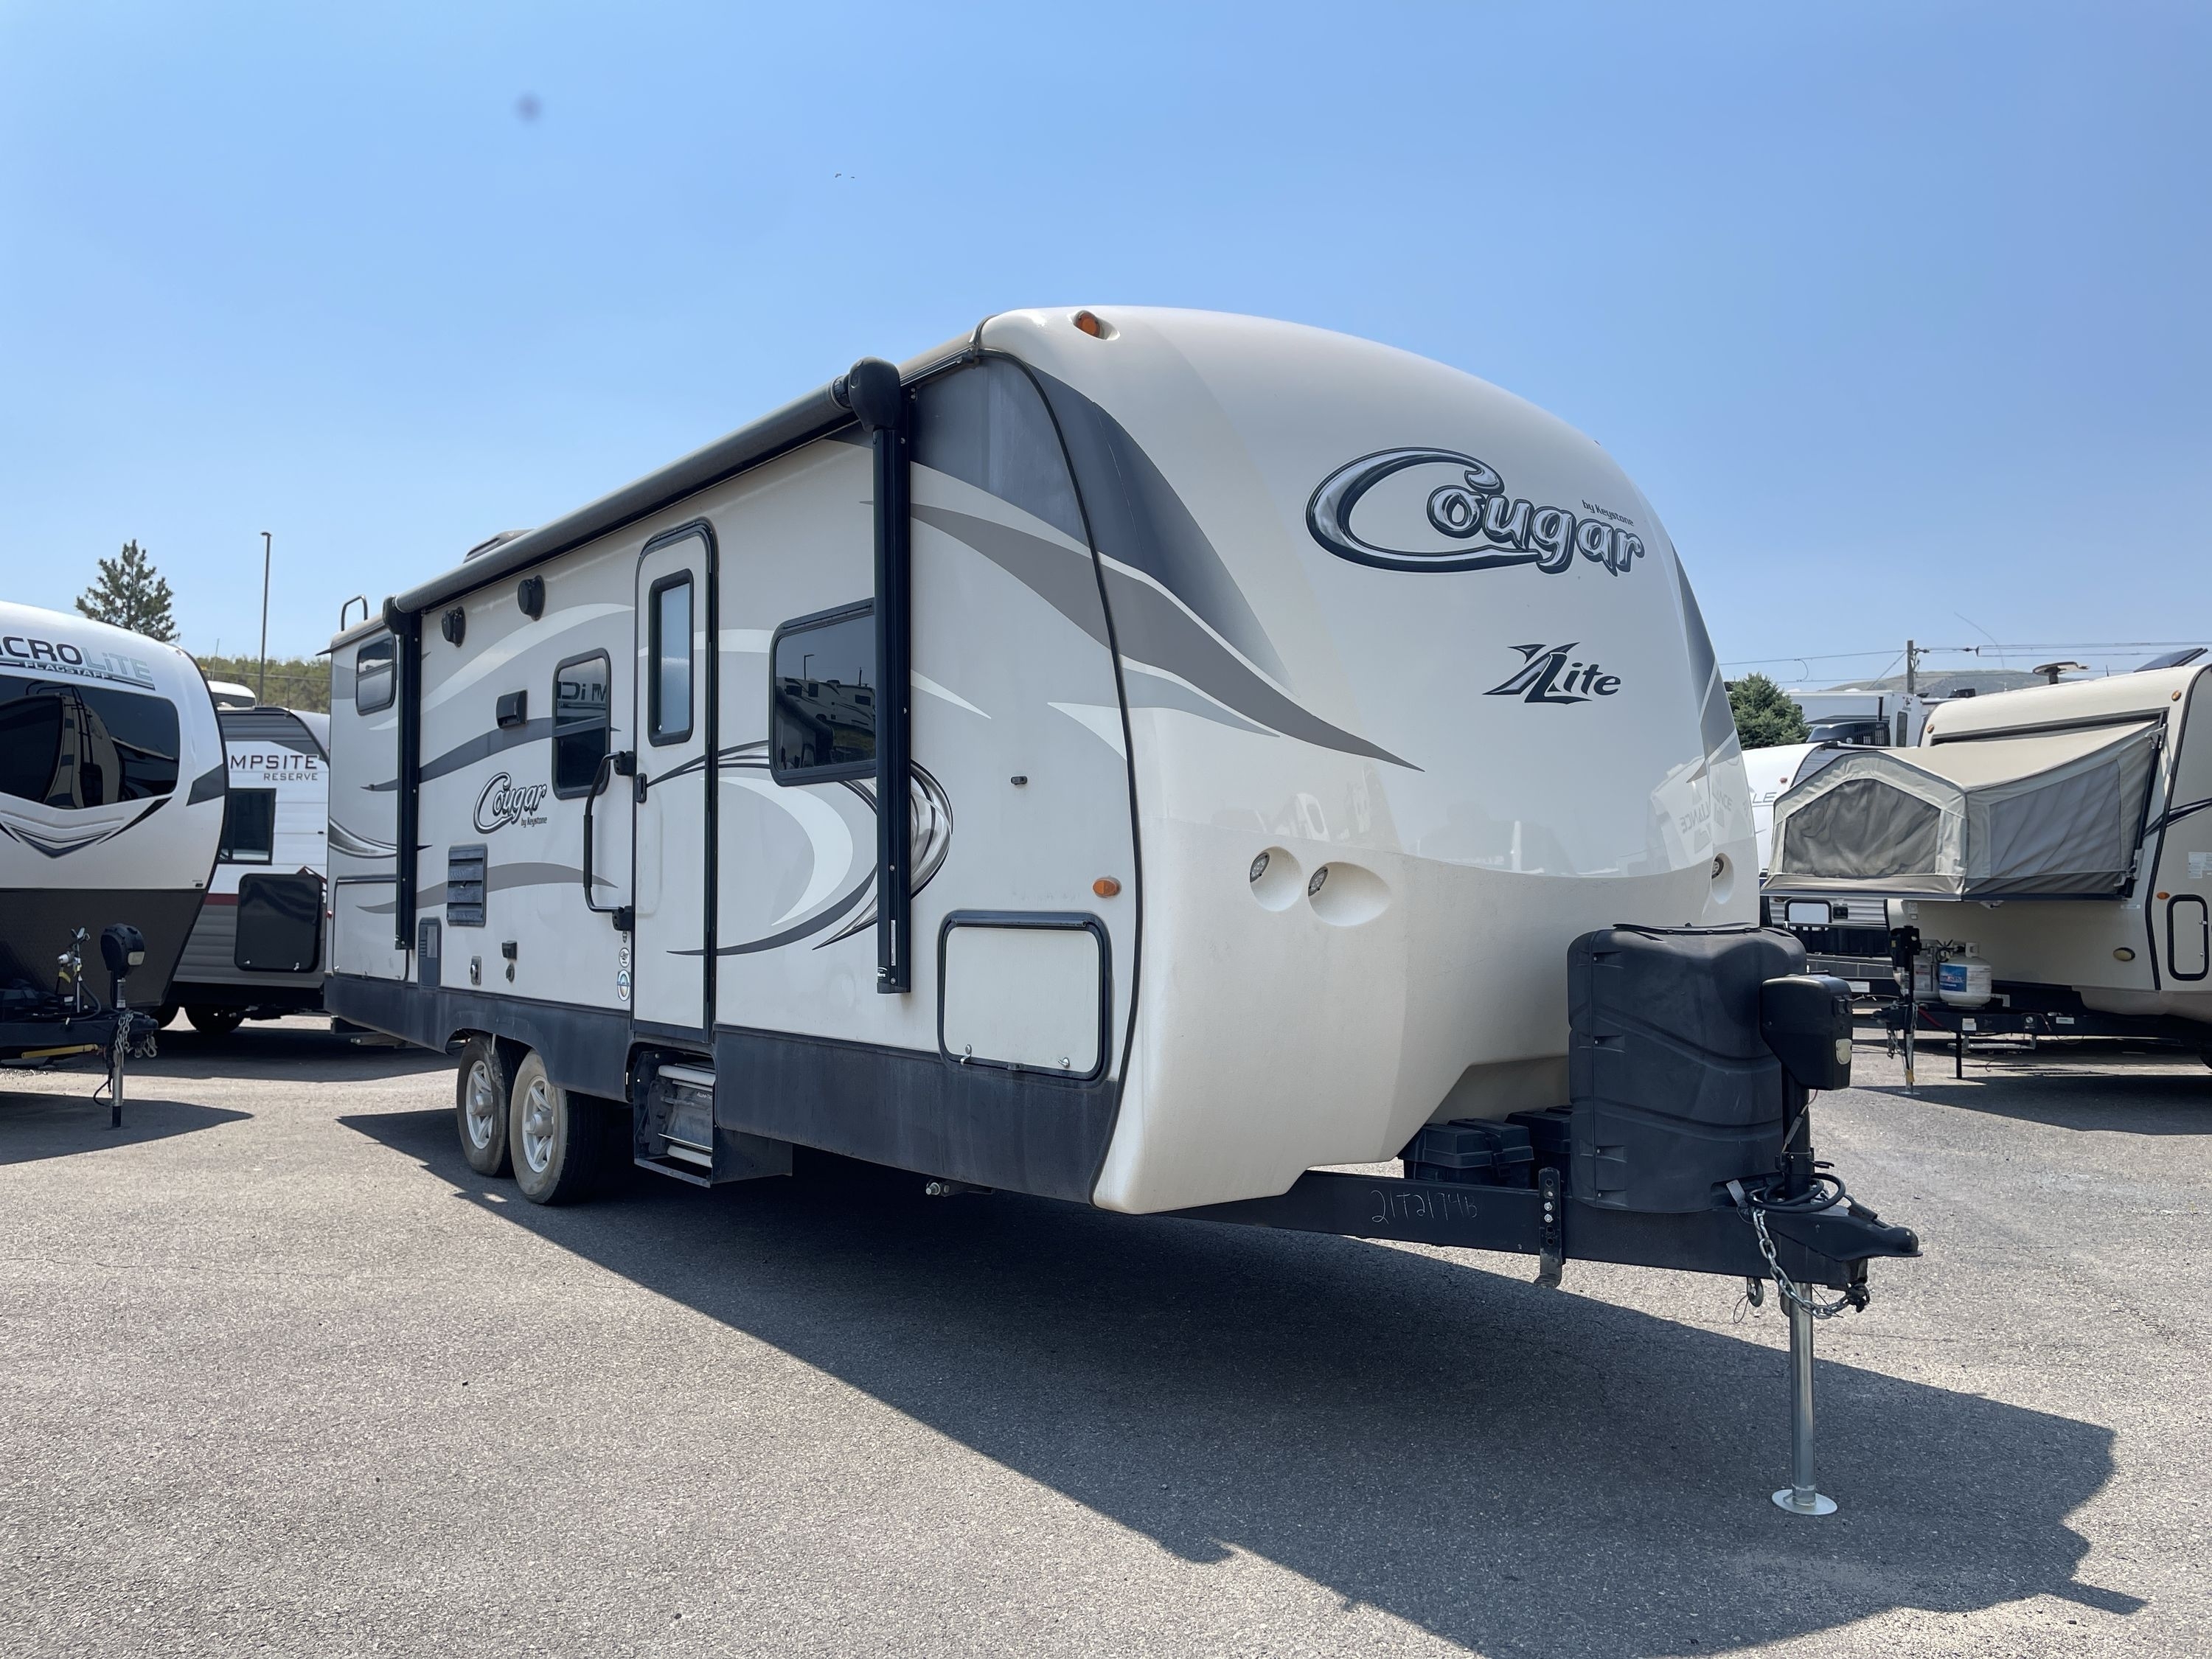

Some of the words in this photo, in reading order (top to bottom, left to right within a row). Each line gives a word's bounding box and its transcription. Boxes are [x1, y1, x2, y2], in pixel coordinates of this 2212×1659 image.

[1305, 446, 1645, 577] Cougar
[1582, 499, 1595, 514] by
[1595, 504, 1635, 527] Keystone
[0, 636, 153, 682] CROLiTE
[24, 661, 111, 679] FLAGSTAFF
[230, 754, 318, 769] MPSITE
[263, 772, 318, 781] RESERVE
[473, 771, 547, 835] Cougar
